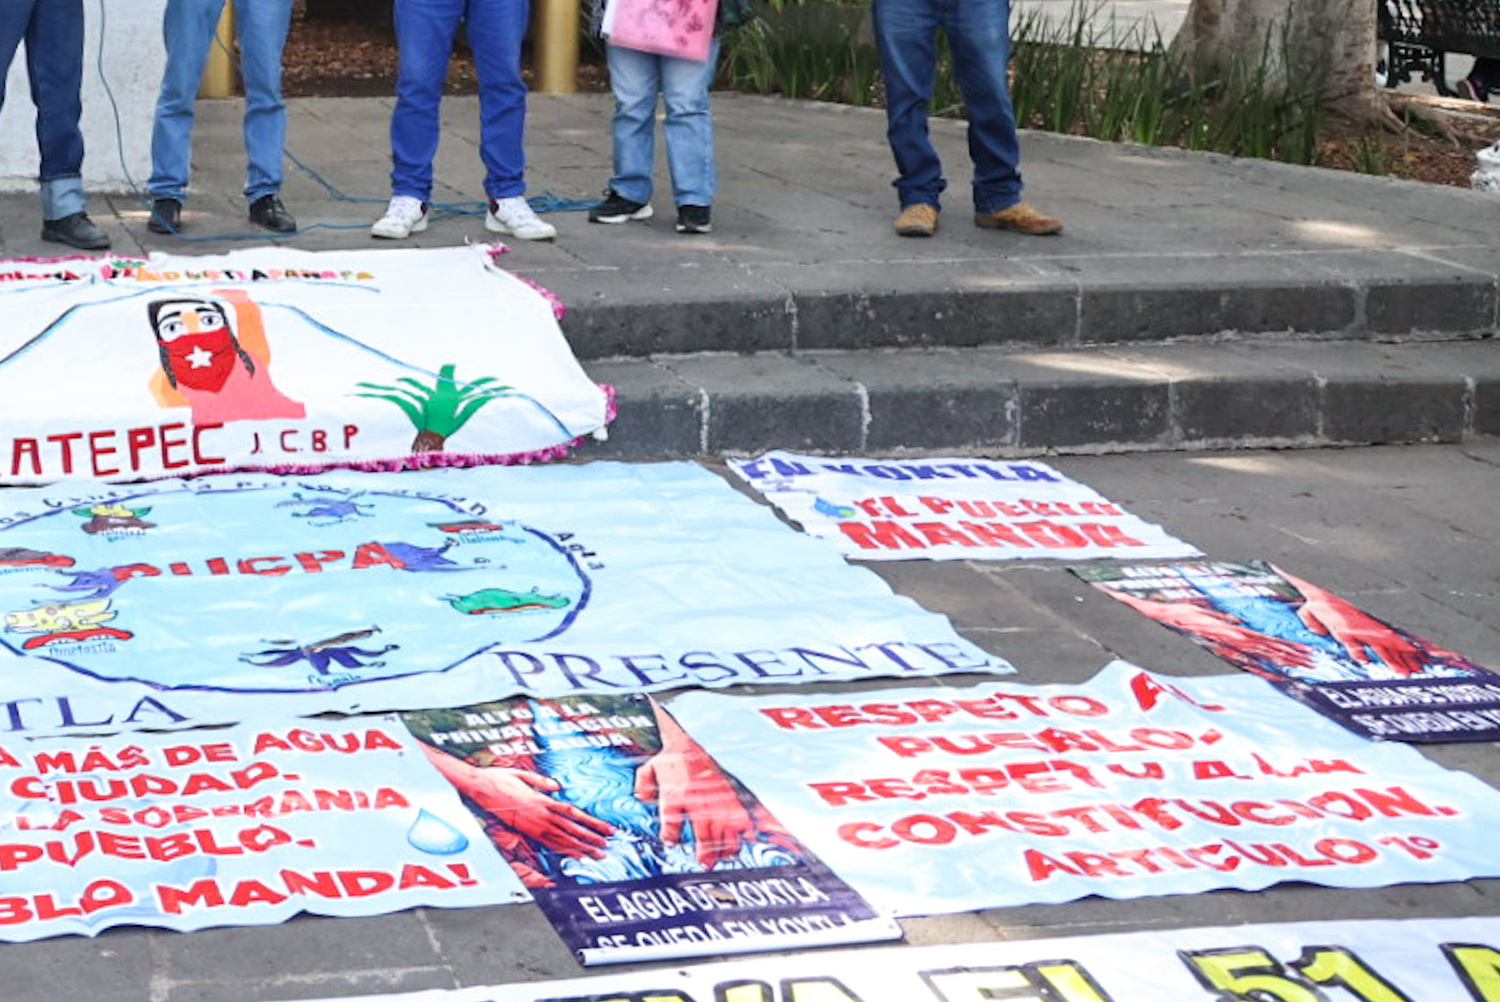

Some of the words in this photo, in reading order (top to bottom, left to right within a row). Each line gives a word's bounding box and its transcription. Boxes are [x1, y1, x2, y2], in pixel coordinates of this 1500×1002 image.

[838, 518, 1149, 550] MANDA
[492, 641, 990, 690] PRESENTE
[464, 706, 535, 728] ALTO
[538, 704, 561, 719] A
[561, 702, 601, 717] LA
[759, 692, 1109, 730] RESPETO
[1130, 670, 1228, 712] AL
[34, 744, 151, 774] MÁS
[164, 743, 238, 767] DE
[253, 728, 405, 755] AGUA
[429, 714, 655, 746] PRIVATIZACIÓN
[489, 740, 548, 756] DEL
[549, 733, 634, 752] AGUA
[17, 808, 83, 832] LA
[1023, 837, 1379, 882] ARTICULO
[156, 862, 480, 915] MANDA!
[577, 896, 624, 924] EL
[619, 887, 699, 921] AGUA
[722, 876, 831, 909] XOXTLA
